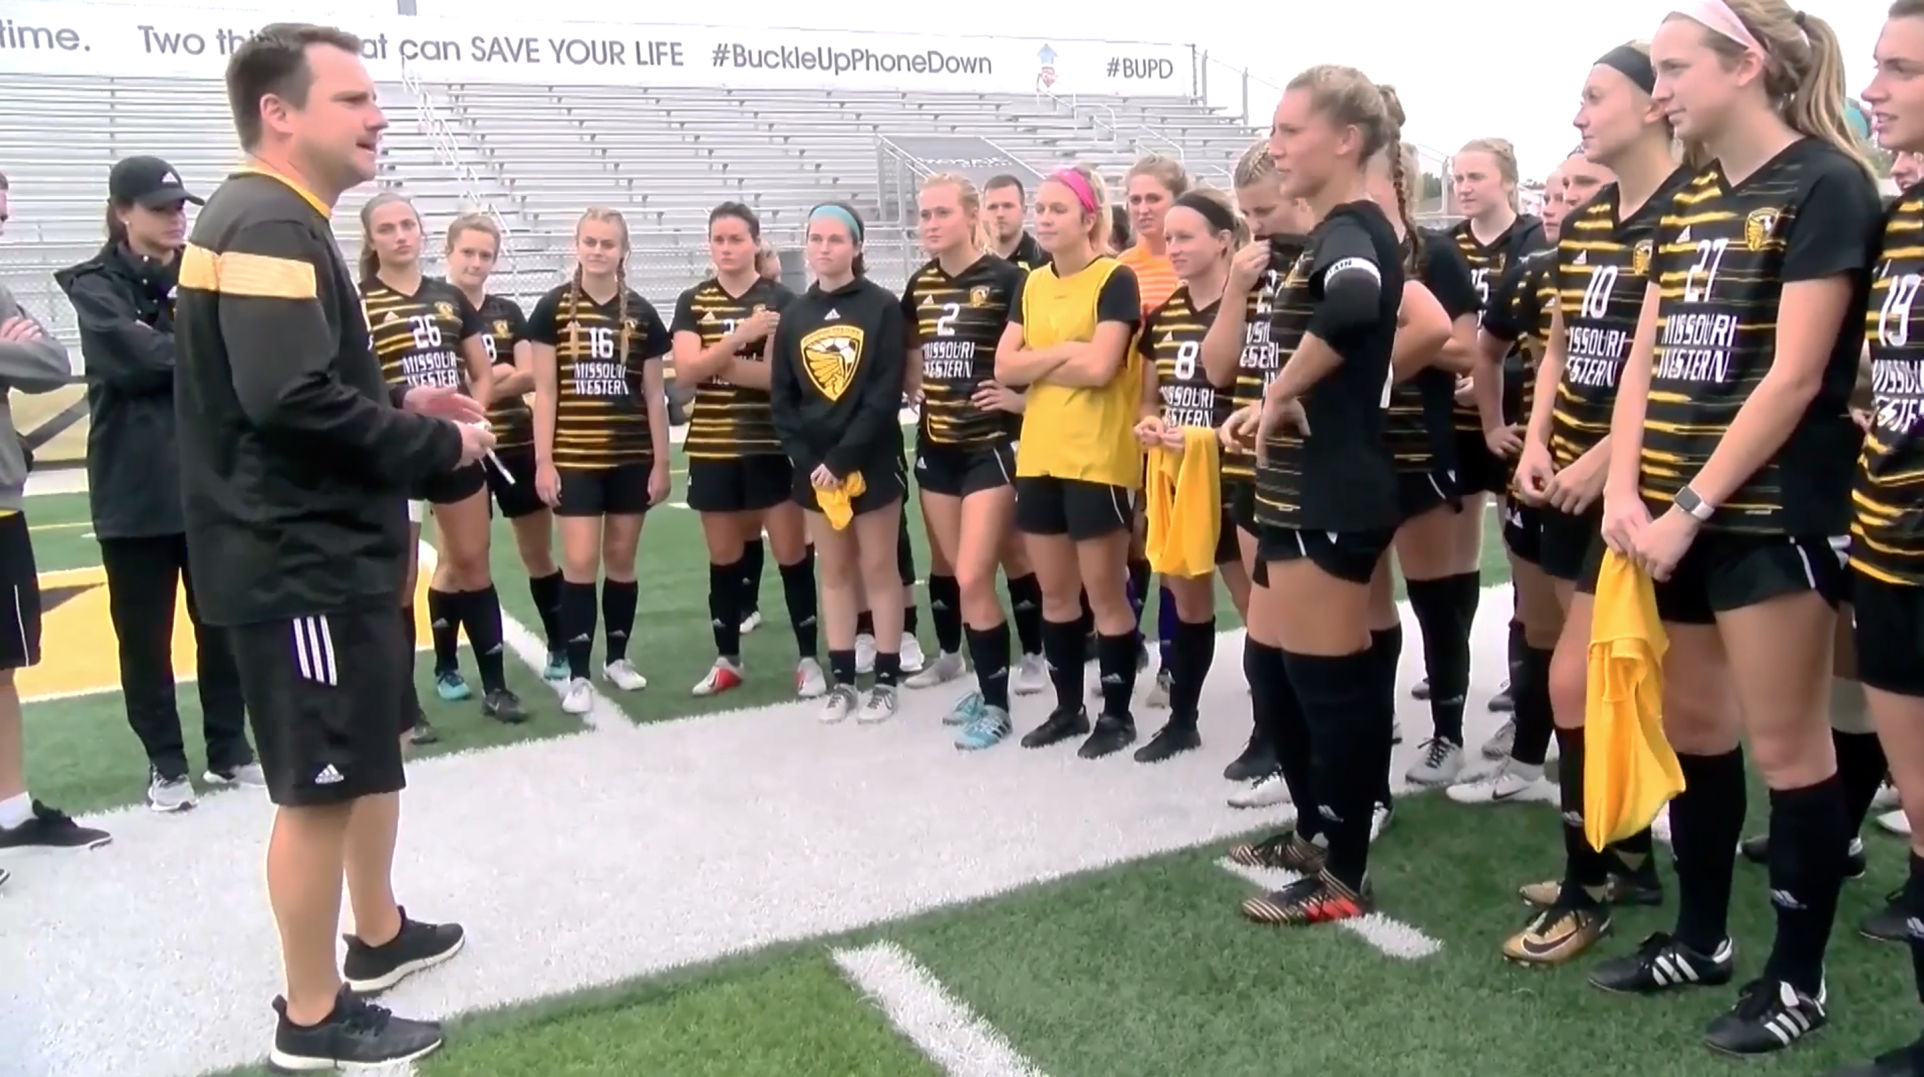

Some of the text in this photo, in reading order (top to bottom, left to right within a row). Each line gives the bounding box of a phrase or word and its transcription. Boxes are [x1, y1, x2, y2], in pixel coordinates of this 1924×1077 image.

[0, 19, 90, 51] time.
[137, 25, 205, 55] Two
[361, 33, 388, 60] at
[399, 38, 461, 61] can
[471, 36, 540, 63] SAVE
[548, 38, 626, 66] YOUR
[636, 40, 684, 66] LIFE
[712, 43, 992, 75] #BuckleUpPhoneDown
[1107, 57, 1174, 79] #BUPD
[1684, 238, 1729, 302] 27
[1581, 265, 1618, 319] 10
[937, 303, 960, 337] 2
[1878, 274, 1922, 346] 19
[408, 314, 442, 349] 26
[590, 327, 614, 358] 16
[1567, 325, 1627, 358] ISSOURI
[1661, 312, 1737, 347] MISSOURI
[402, 350, 457, 374] MISSOUR
[1175, 341, 1198, 380] 8
[1566, 355, 1618, 388] ESTERN
[1657, 348, 1730, 383] WESTERN
